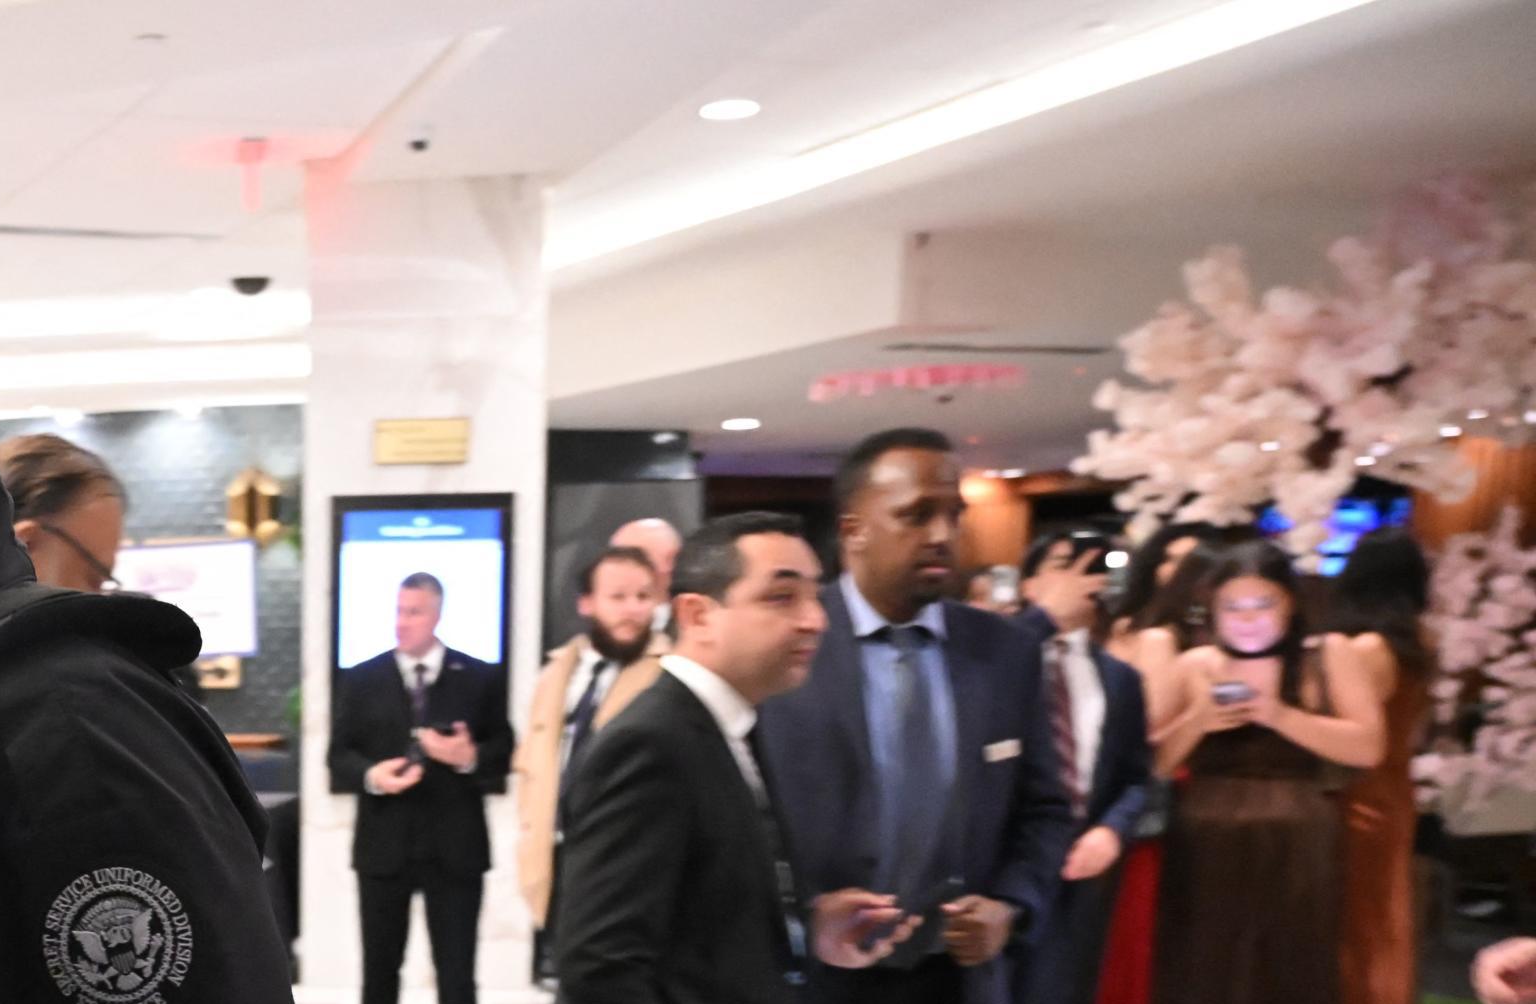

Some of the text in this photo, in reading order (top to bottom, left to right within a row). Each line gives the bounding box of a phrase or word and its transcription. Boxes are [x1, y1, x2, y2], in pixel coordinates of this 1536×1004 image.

[44, 873, 94, 931] SERVICE
[93, 867, 182, 914] UNIFORMED
[43, 934, 77, 997] SECRET
[167, 913, 193, 987] DIVISION
